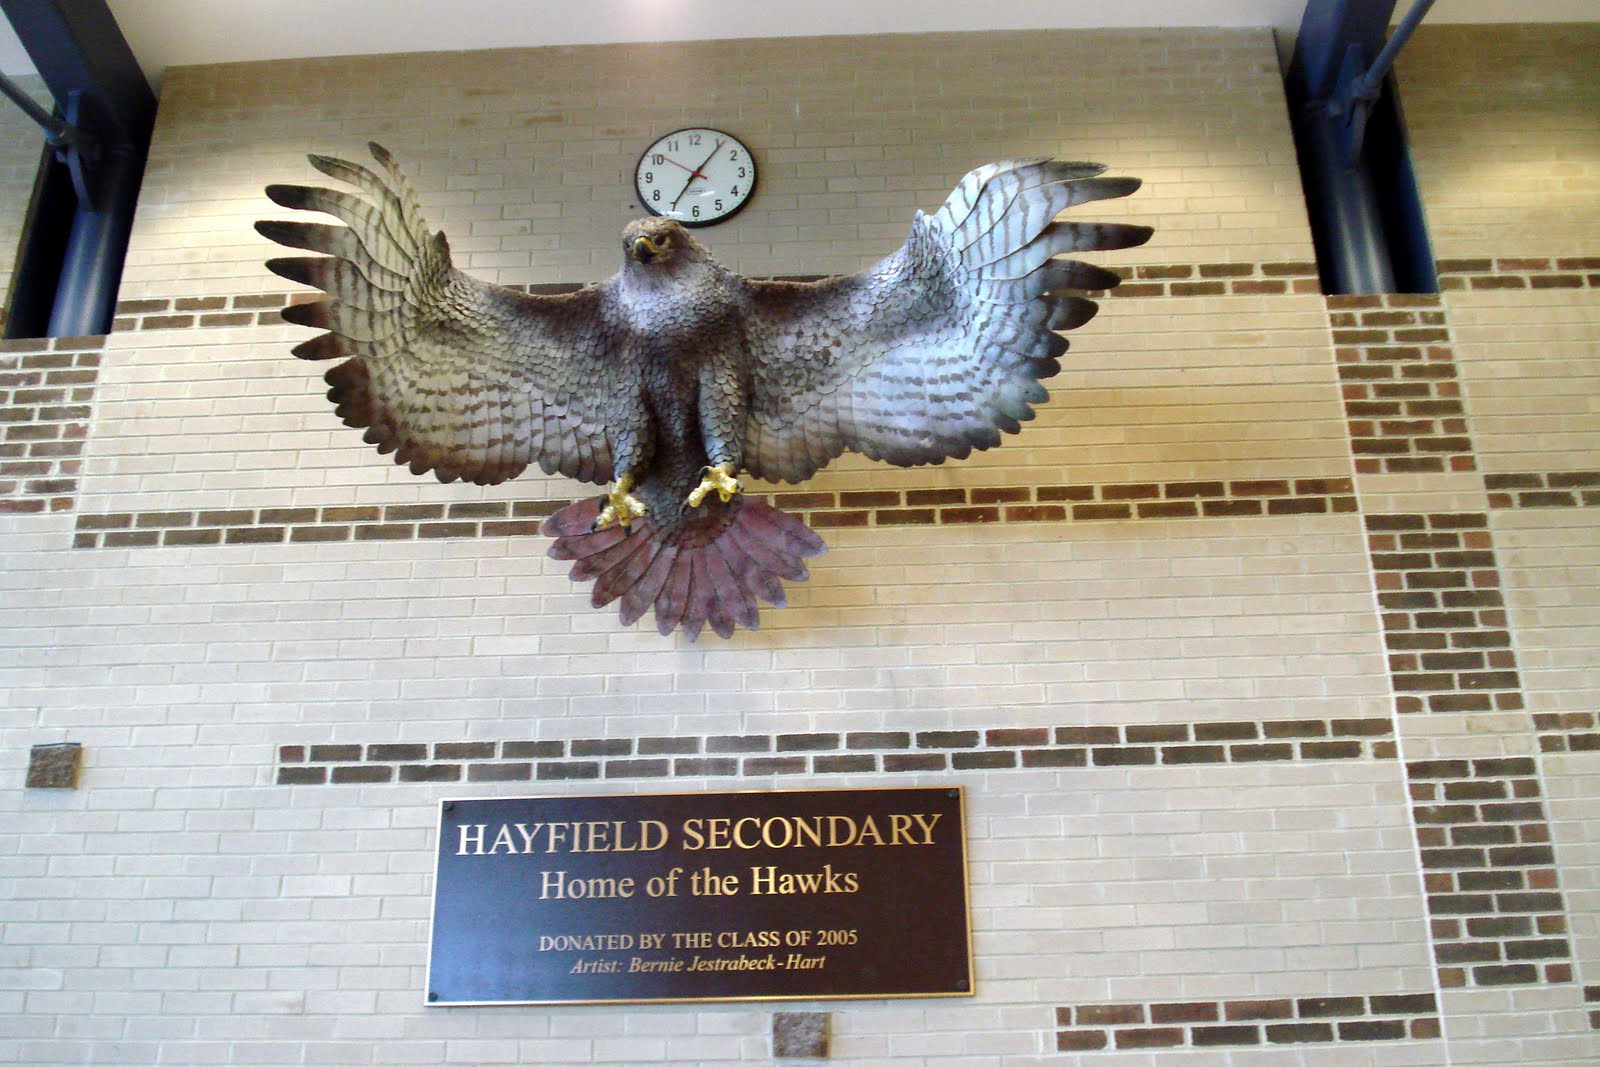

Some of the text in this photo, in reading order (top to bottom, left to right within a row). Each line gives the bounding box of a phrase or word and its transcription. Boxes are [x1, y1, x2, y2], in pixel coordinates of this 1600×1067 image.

[666, 140, 679, 152] 11
[688, 134, 702, 146] 12
[651, 153, 665, 166] 10
[729, 149, 738, 162] 2
[645, 171, 654, 184] 9
[737, 166, 746, 179] 3
[652, 189, 661, 202] 8
[730, 184, 739, 197] 4
[669, 201, 677, 212] 7
[691, 205, 700, 218] 6
[714, 199, 723, 212] 5
[455, 813, 943, 856] HAYFIELD SECONDARY
[538, 863, 860, 900] Home of the Hawks
[538, 929, 858, 952] DONATED BY THE CLASS OF 2005
[569, 953, 826, 974] Artist: Bernie Jestrabeck-Hart
